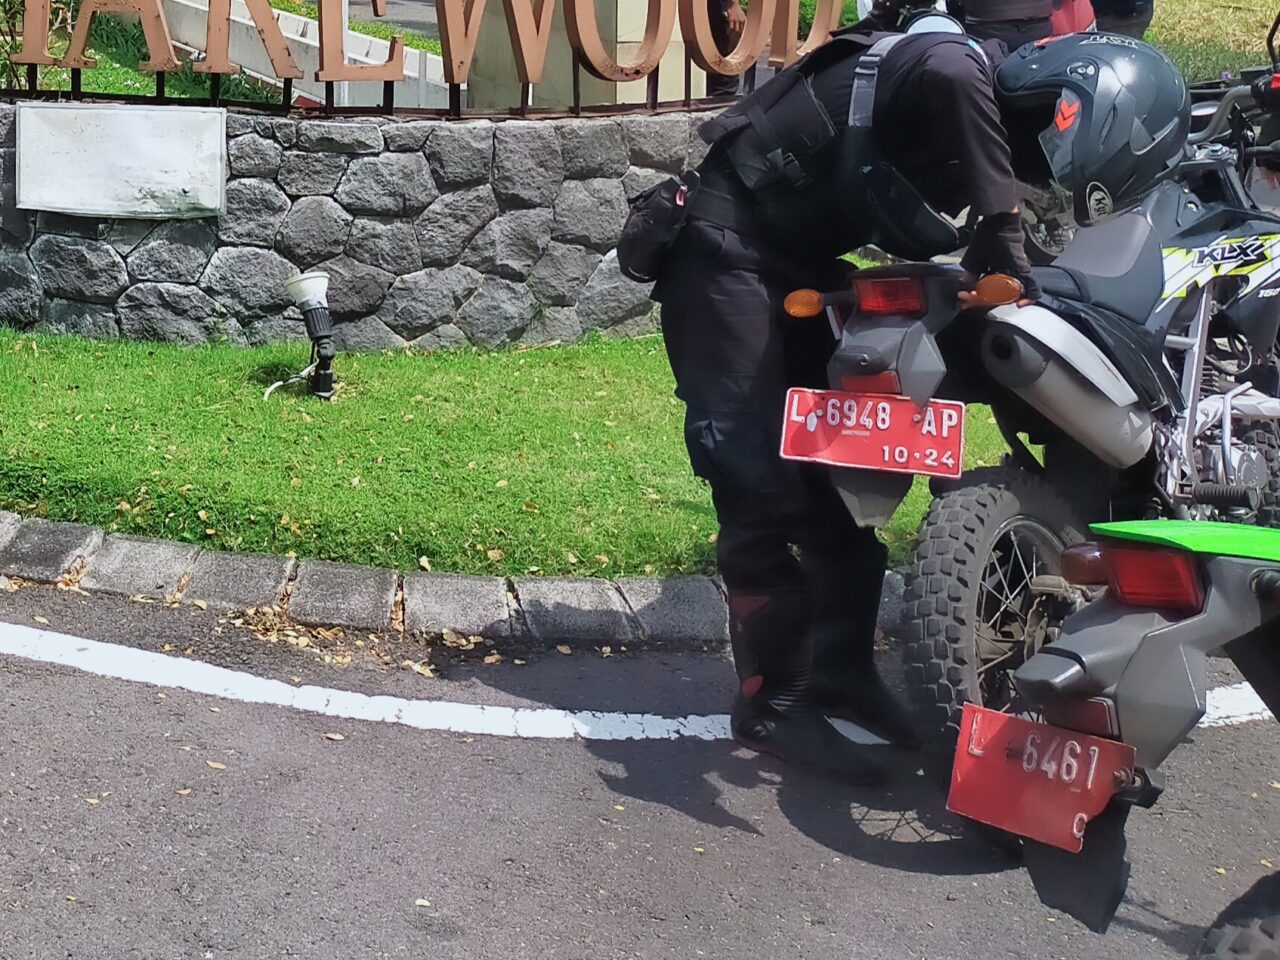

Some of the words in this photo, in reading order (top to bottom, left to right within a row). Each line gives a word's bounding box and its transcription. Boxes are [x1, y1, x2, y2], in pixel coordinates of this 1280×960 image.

[1191, 238, 1265, 269] KLX
[790, 393, 806, 424] L
[826, 398, 892, 431] 6948
[921, 406, 959, 438] AP
[967, 712, 986, 758] L
[1022, 730, 1099, 790] 6461
